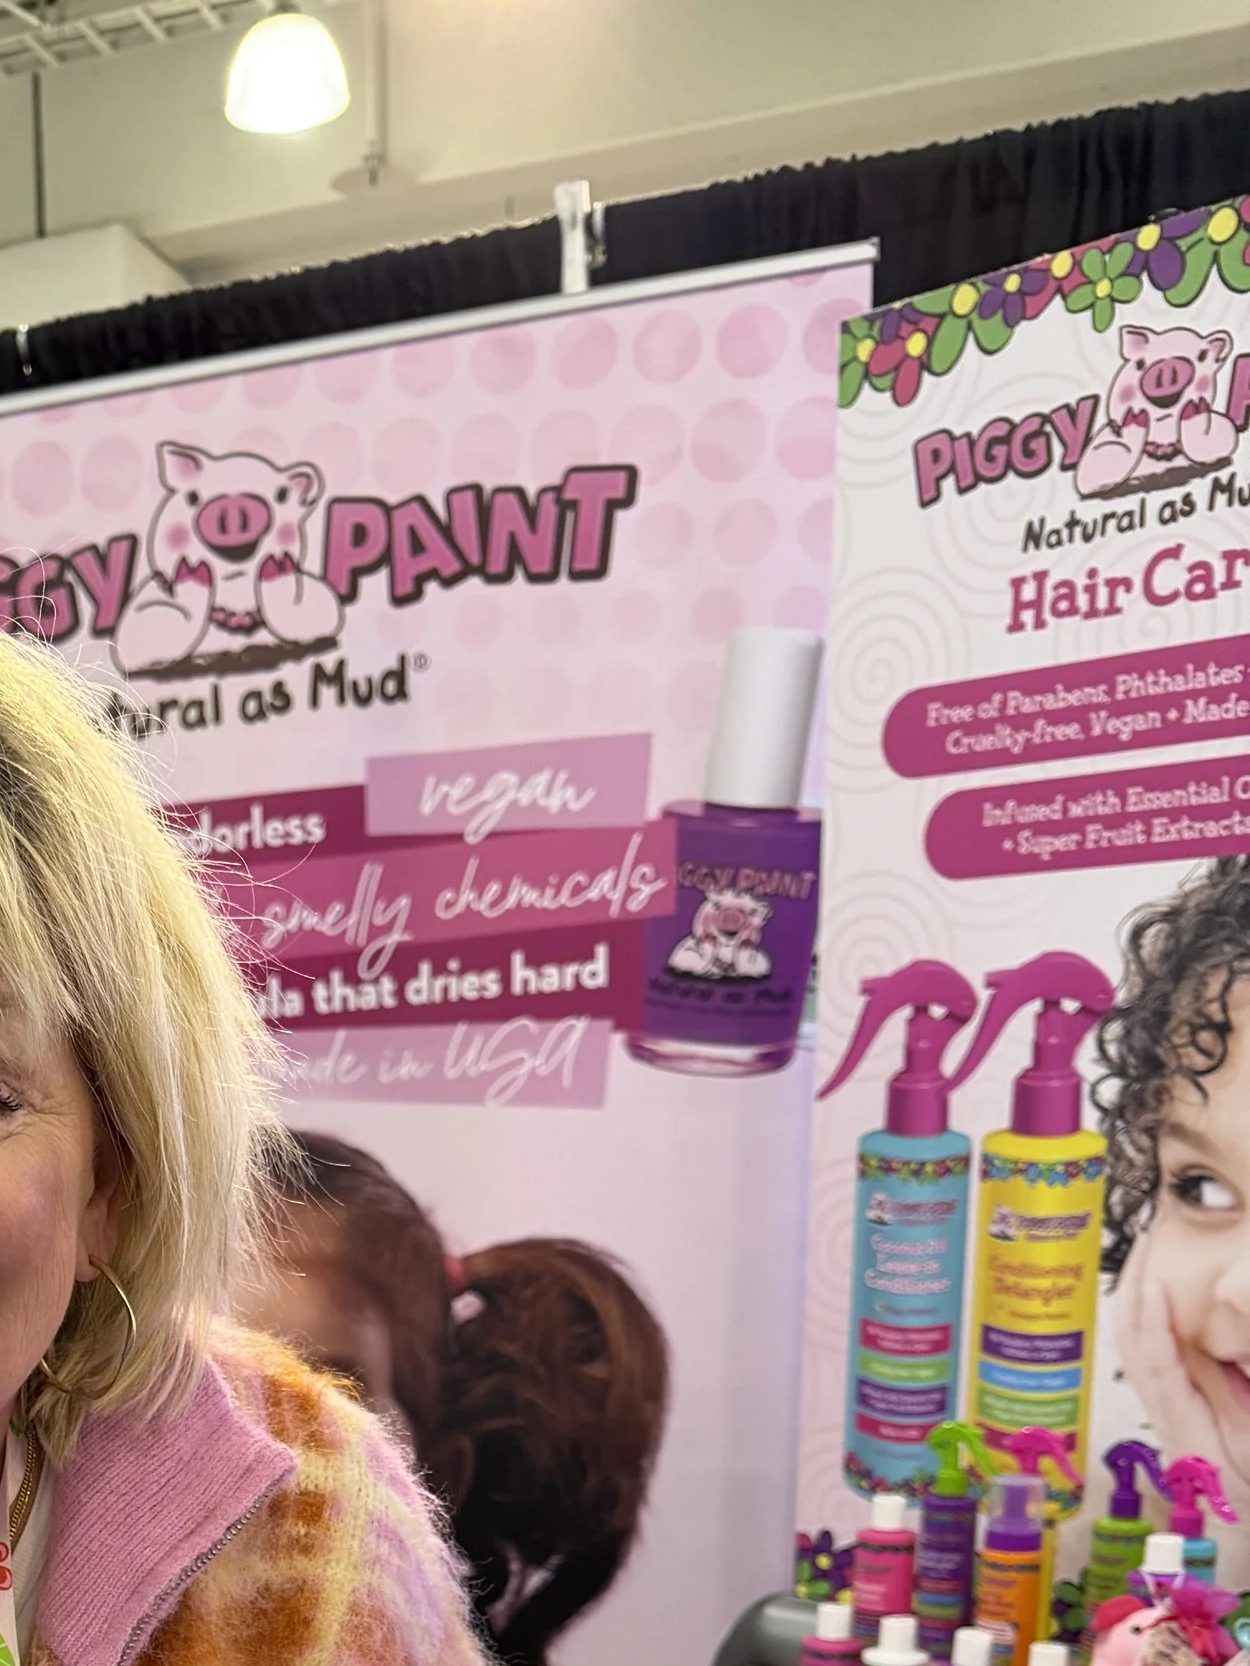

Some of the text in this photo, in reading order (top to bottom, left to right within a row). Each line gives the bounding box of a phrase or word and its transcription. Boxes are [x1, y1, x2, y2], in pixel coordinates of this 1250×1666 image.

[914, 394, 1100, 509] PIGGY
[322, 464, 639, 607] PAINT
[1022, 499, 1148, 553] Natural
[1159, 493, 1197, 525] as
[1006, 566, 1134, 634] Hair
[240, 679, 291, 725] as
[927, 701, 975, 728] Free
[977, 693, 1003, 721] of
[1114, 661, 1245, 701] Phthalates
[1089, 709, 1162, 741] Vegan
[421, 763, 596, 846] vegan
[982, 793, 1064, 828] Infused
[1066, 789, 1123, 819] with
[1124, 776, 1231, 813] Essential
[1016, 827, 1083, 861] Super
[1084, 819, 1148, 850] Fruit
[262, 831, 668, 981] smelly chemicals
[312, 942, 609, 1014] that dries hard
[378, 1012, 591, 1108] in USA
